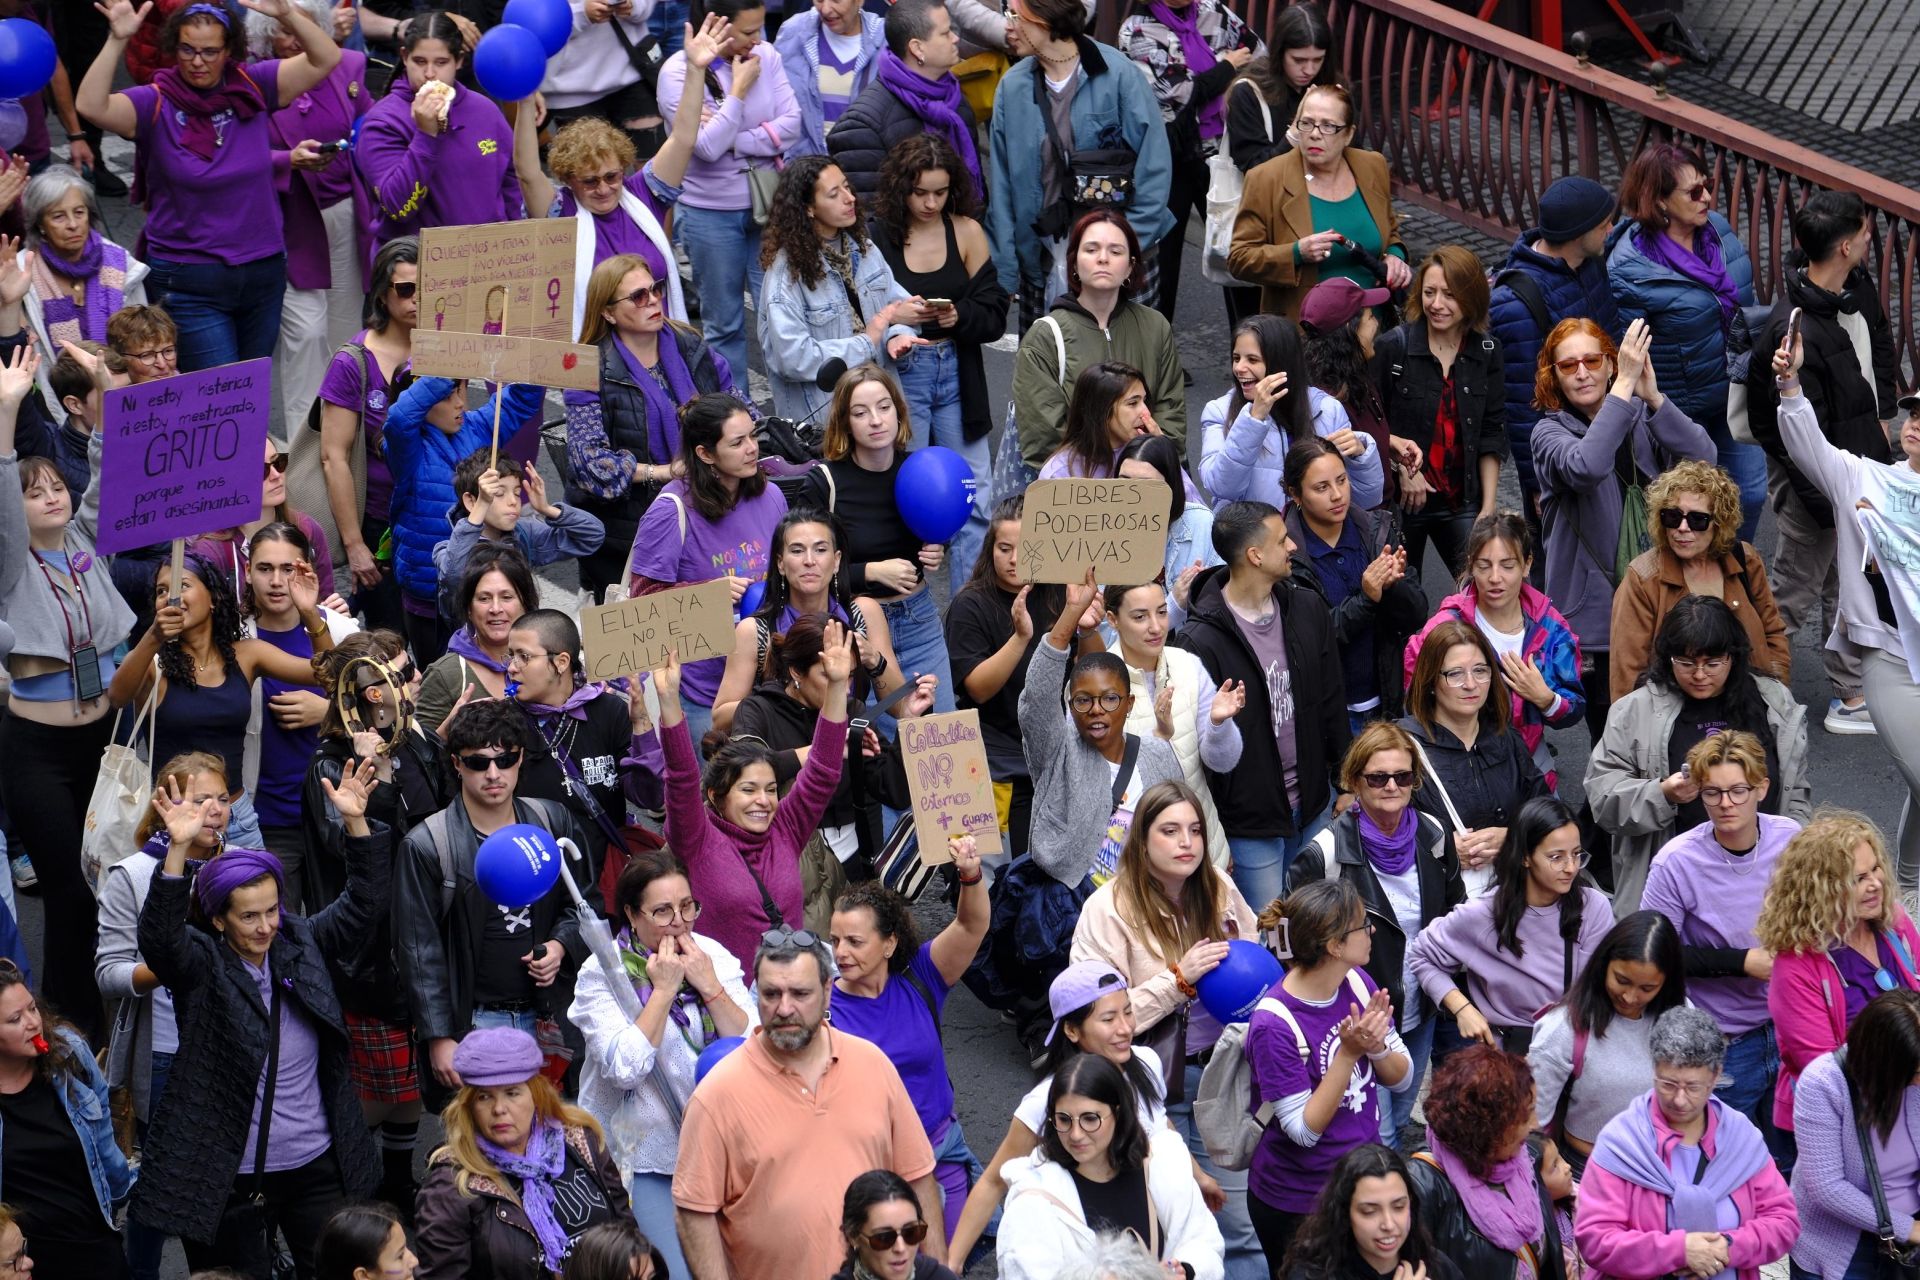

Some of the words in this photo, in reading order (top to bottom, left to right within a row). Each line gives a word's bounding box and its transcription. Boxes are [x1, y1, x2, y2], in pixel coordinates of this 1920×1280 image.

[502, 238, 530, 249] TODAS
[121, 395, 136, 413] Ni
[148, 387, 182, 408] estoy
[120, 422, 130, 437] ni
[134, 412, 168, 433] estoy
[144, 418, 239, 477] GRITO
[135, 484, 184, 508] porque
[197, 476, 226, 490] nos
[1052, 484, 1141, 506] LIBRES
[1035, 511, 1161, 533] PODEROSAS
[1052, 538, 1131, 563] VIVAS
[600, 602, 661, 634] ELLA
[673, 593, 703, 613] YA
[633, 627, 655, 646] NO
[594, 633, 711, 677] CALLAITA
[918, 753, 953, 790] NO
[920, 792, 971, 811] estamos
